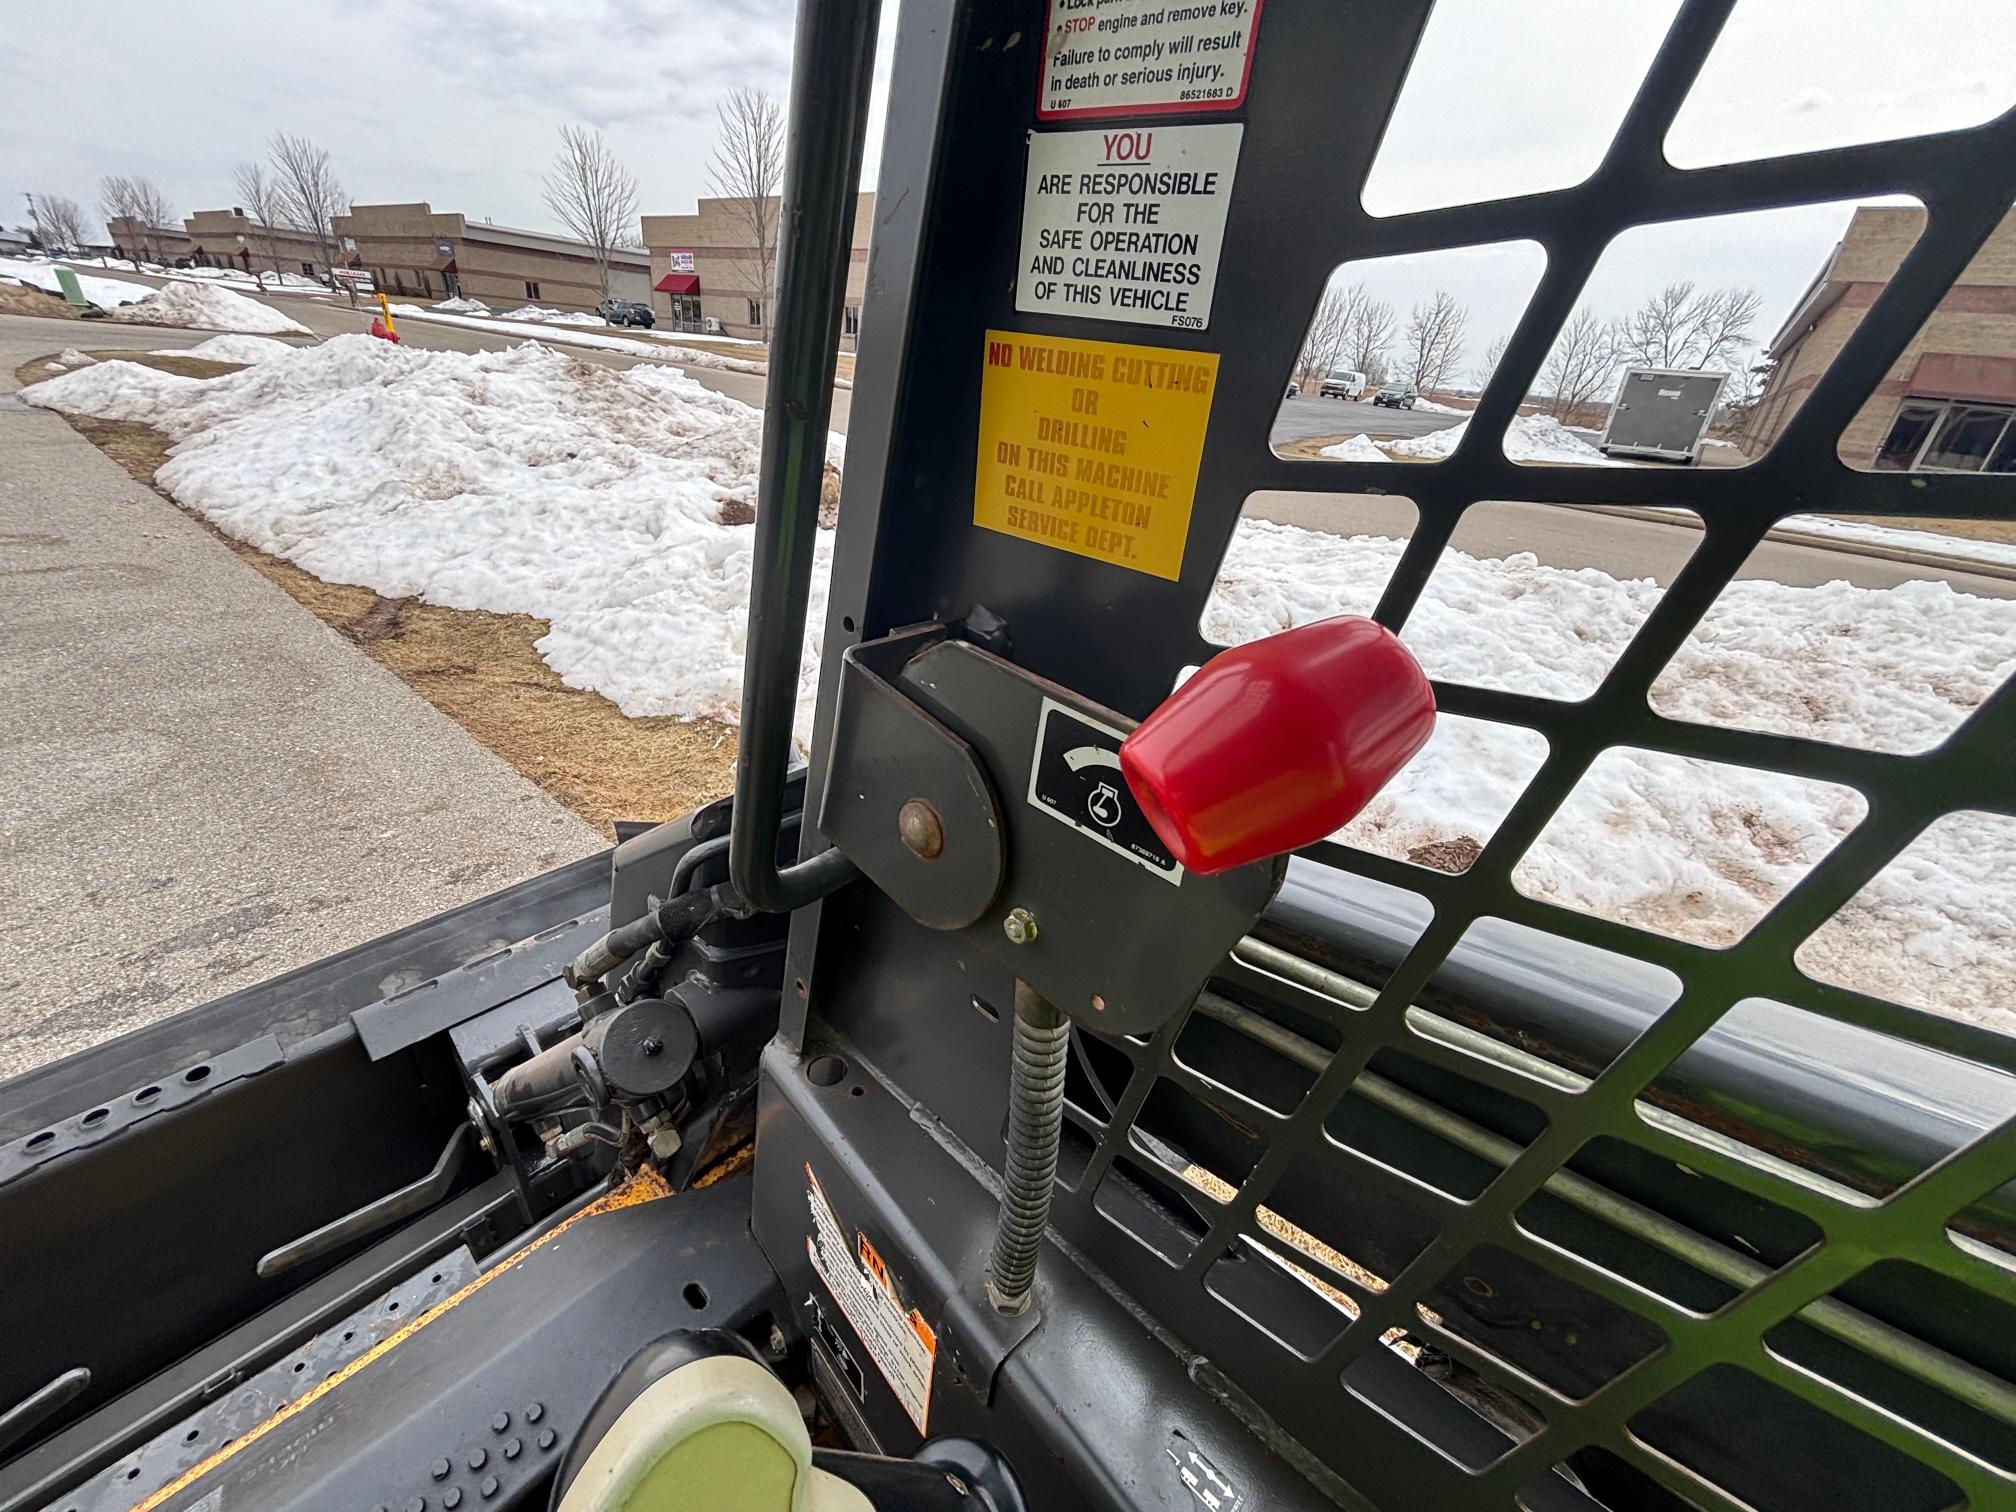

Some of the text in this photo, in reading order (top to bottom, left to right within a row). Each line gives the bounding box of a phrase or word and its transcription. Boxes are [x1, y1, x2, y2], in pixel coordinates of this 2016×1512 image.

[1065, 1, 1248, 34] STOP engine and remove key.
[1053, 31, 1242, 67] Failure to comply will result
[1051, 63, 1225, 91] in death or serious injury.
[1050, 100, 1057, 109] U
[1180, 87, 1234, 100] 86521683 D
[1103, 132, 1153, 161] YOU
[1037, 172, 1218, 195] ARE RESPONSIBLE
[1076, 202, 1160, 224] FOR THE
[1039, 229, 1198, 256] SAFE OPERATION
[1030, 255, 1202, 285] AND CLEANLINESS
[1034, 281, 1190, 312] OF THIS VEHICLE
[1171, 315, 1203, 328] FS076
[989, 342, 1210, 394] NO WELDING CUTTING
[1071, 387, 1100, 416] OR
[1037, 416, 1128, 456] DRILLING
[997, 441, 1171, 500] ON THIS MACHINE
[1005, 474, 1152, 530] CALL APPLETON
[1007, 505, 1137, 559] SERVICE DEPT.
